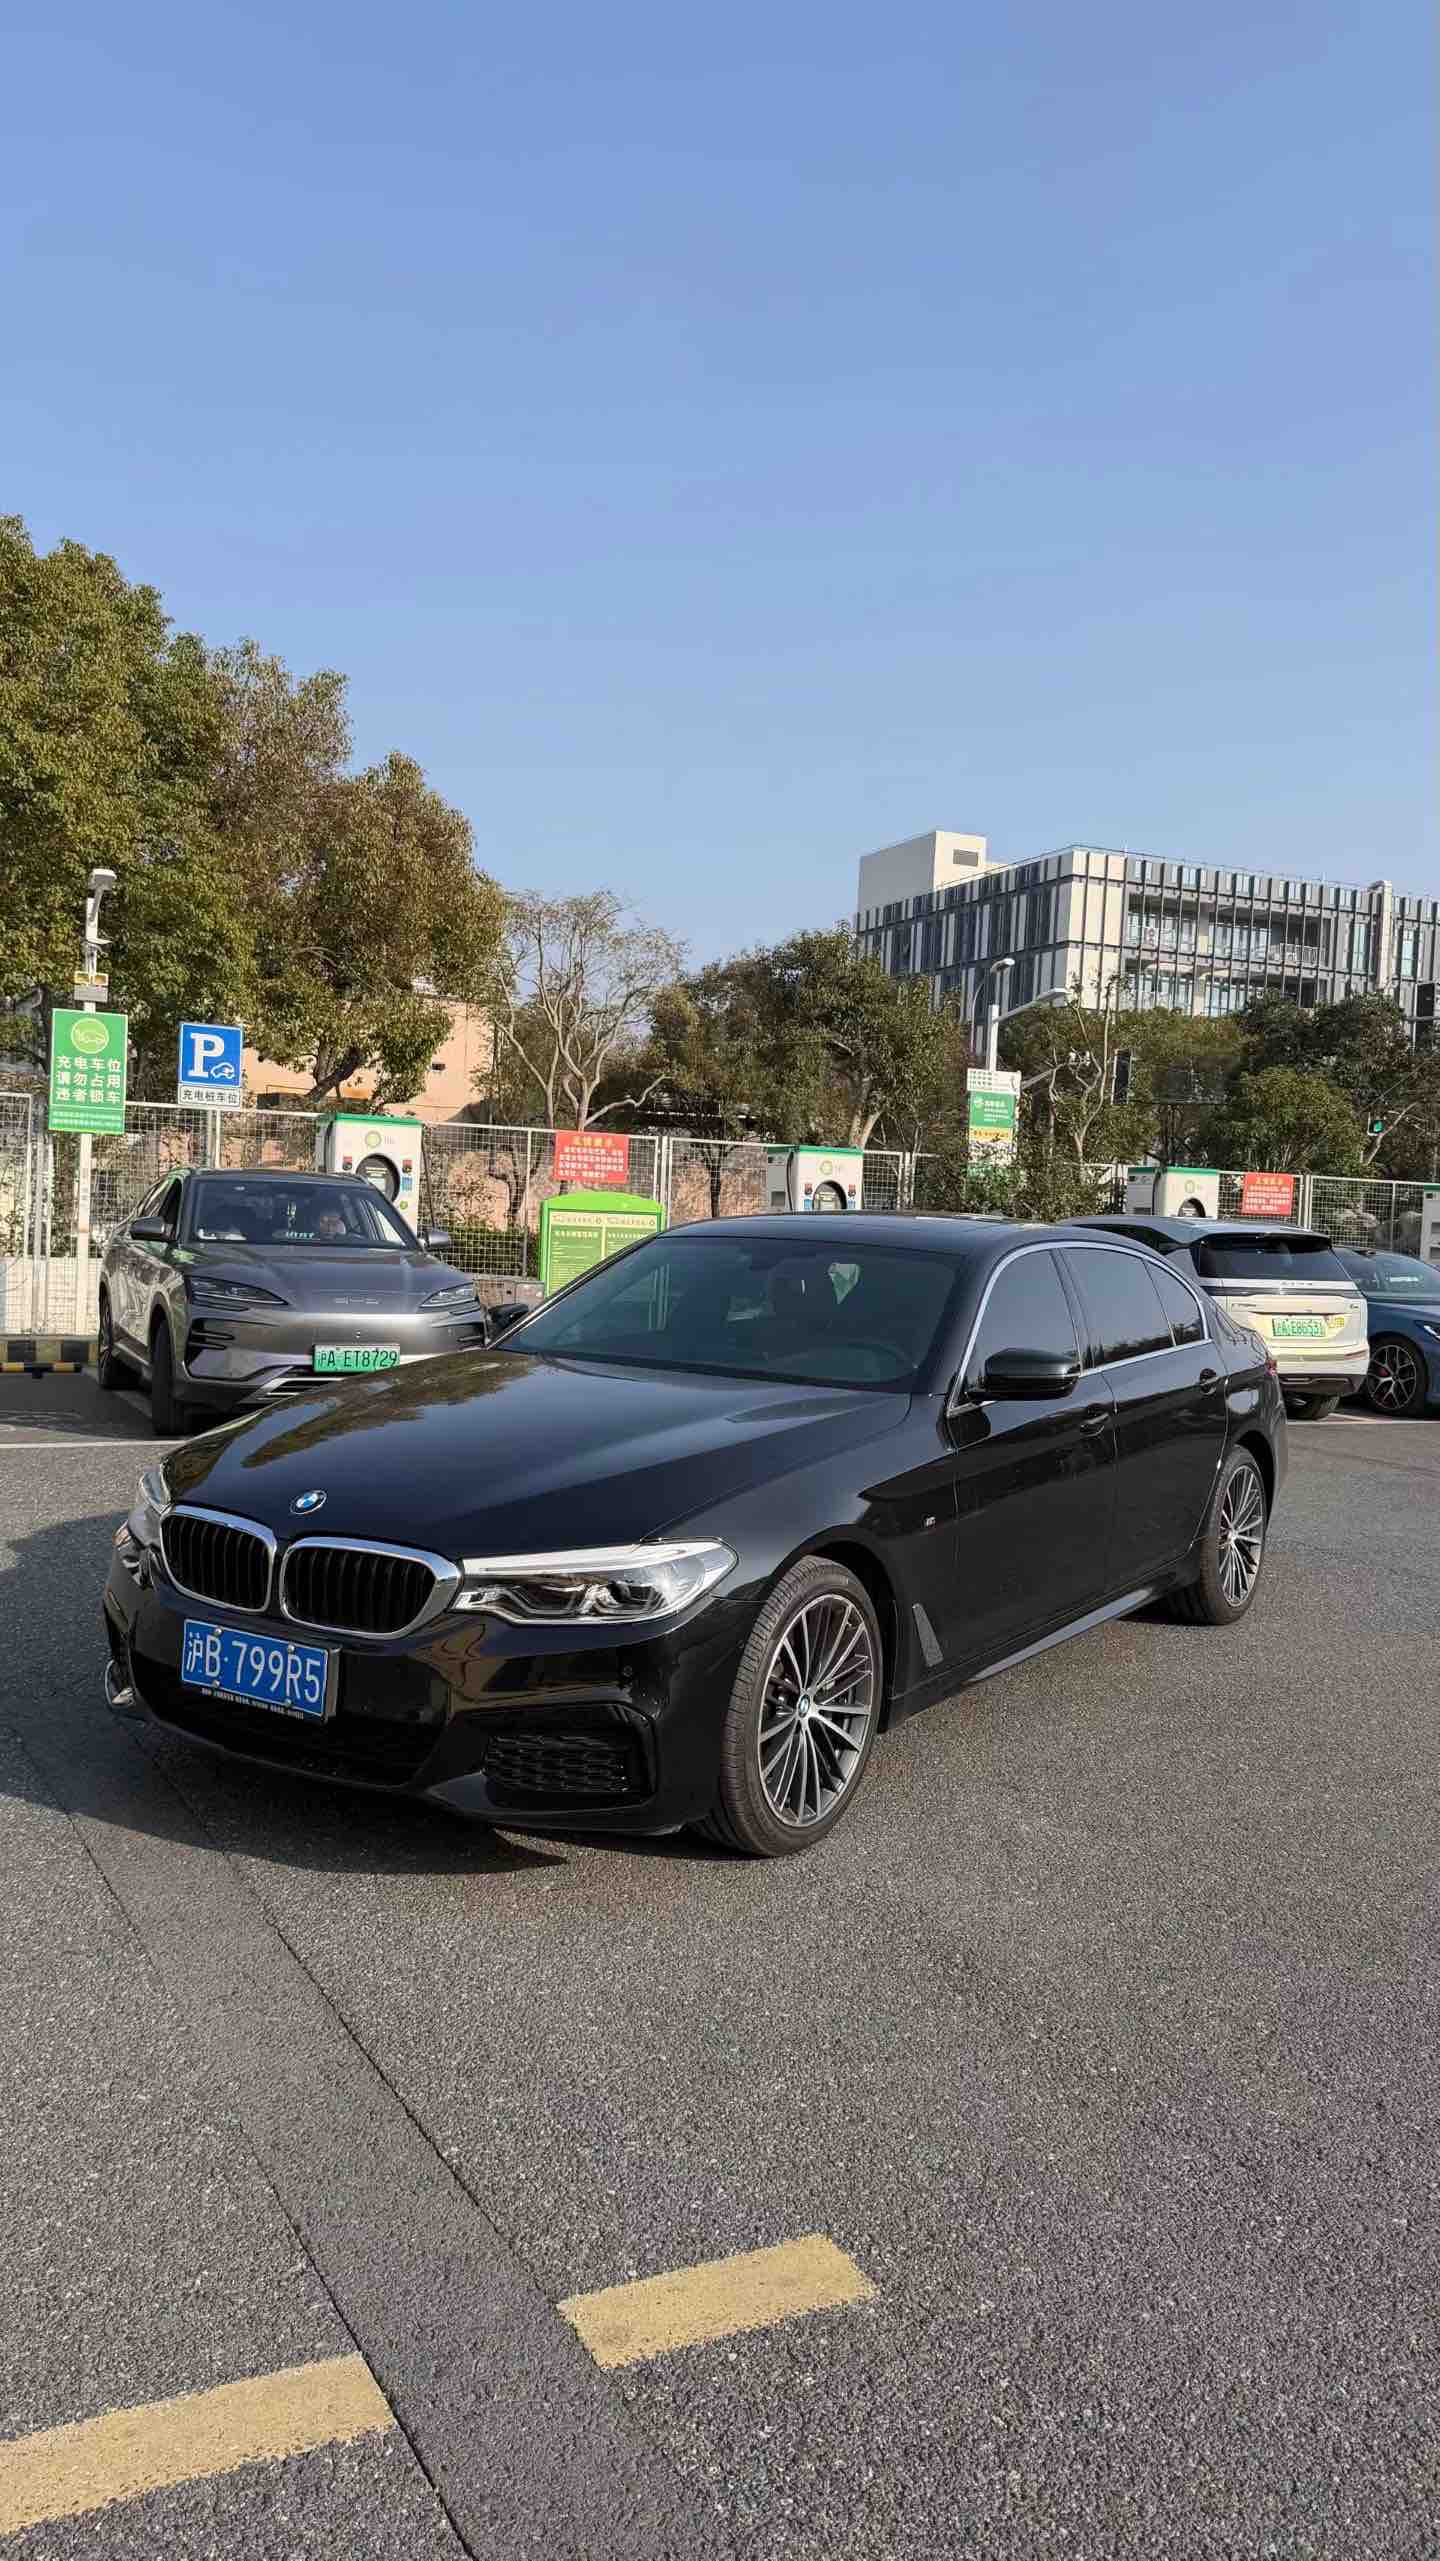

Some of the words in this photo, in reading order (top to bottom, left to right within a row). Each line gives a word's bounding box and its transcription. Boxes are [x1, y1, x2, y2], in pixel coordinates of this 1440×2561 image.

[55, 1055, 121, 1073] 充电车位
[188, 1032, 224, 1078] P
[55, 1070, 121, 1088] 请勿占用
[343, 1350, 398, 1367] ET8729
